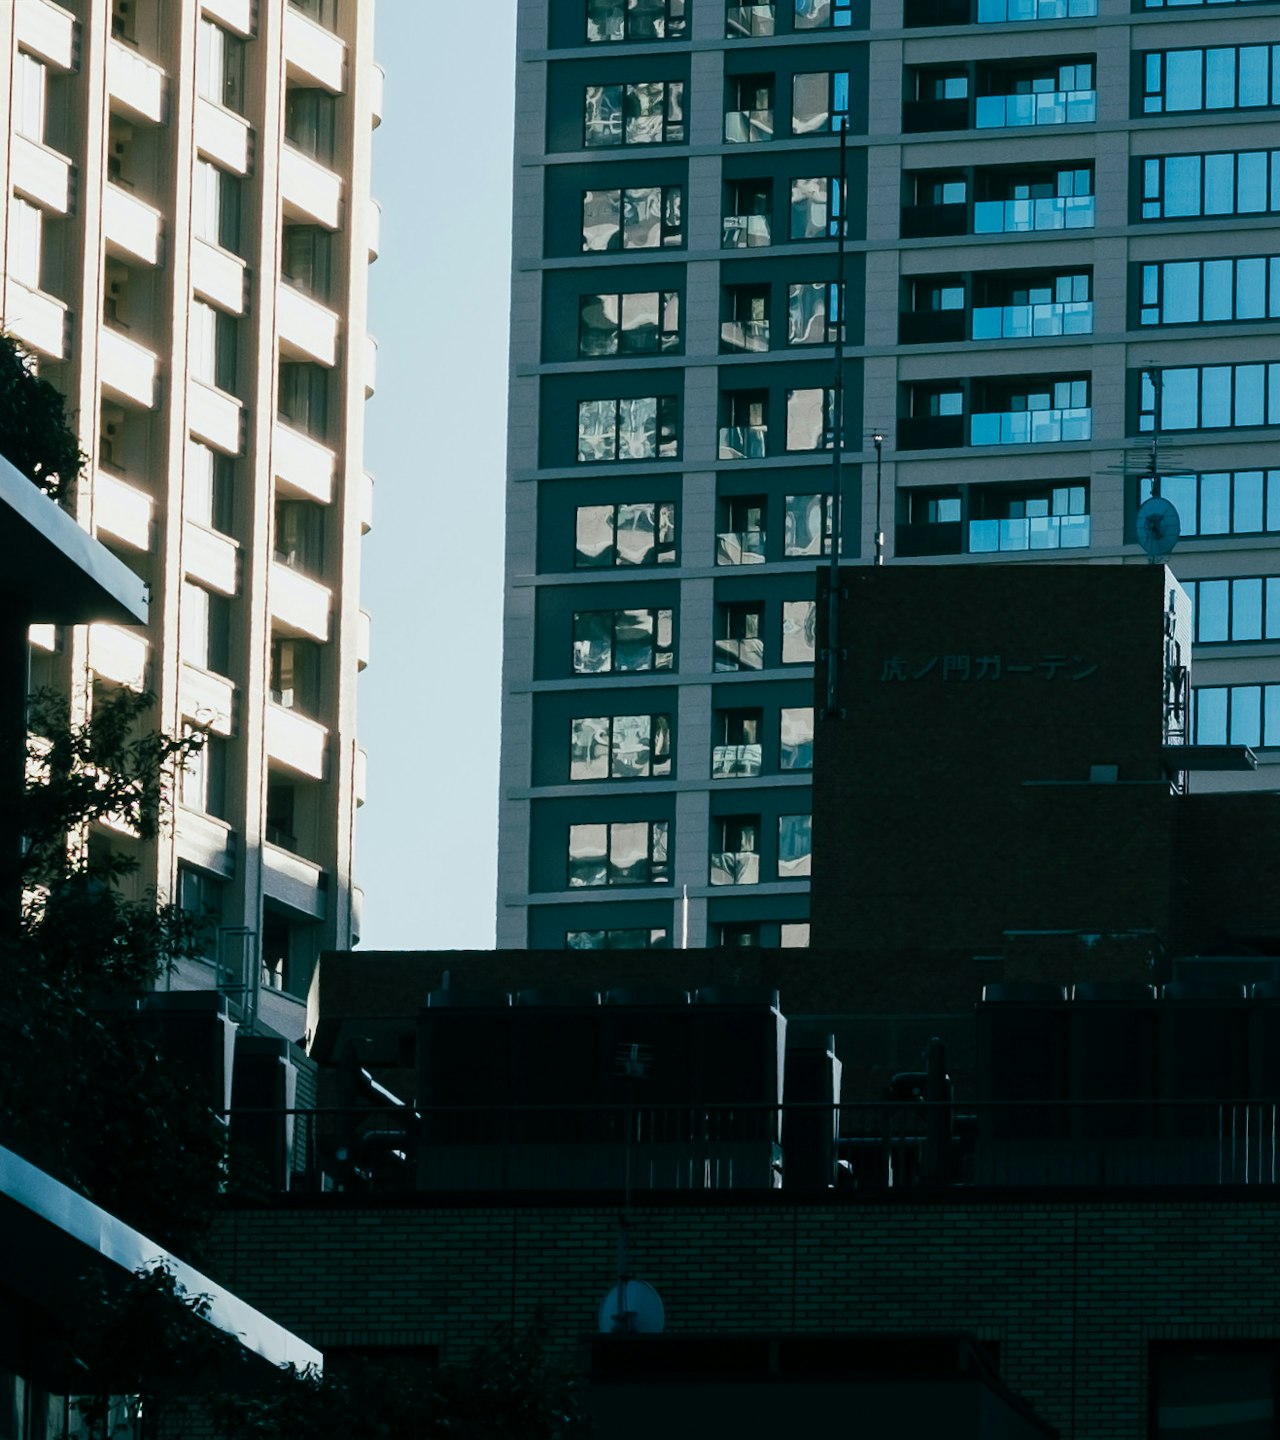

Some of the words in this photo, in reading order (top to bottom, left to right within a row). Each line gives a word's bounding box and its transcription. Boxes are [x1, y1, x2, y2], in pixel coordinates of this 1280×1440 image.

[880, 655, 1098, 681] 虎ノ門ガーデン
